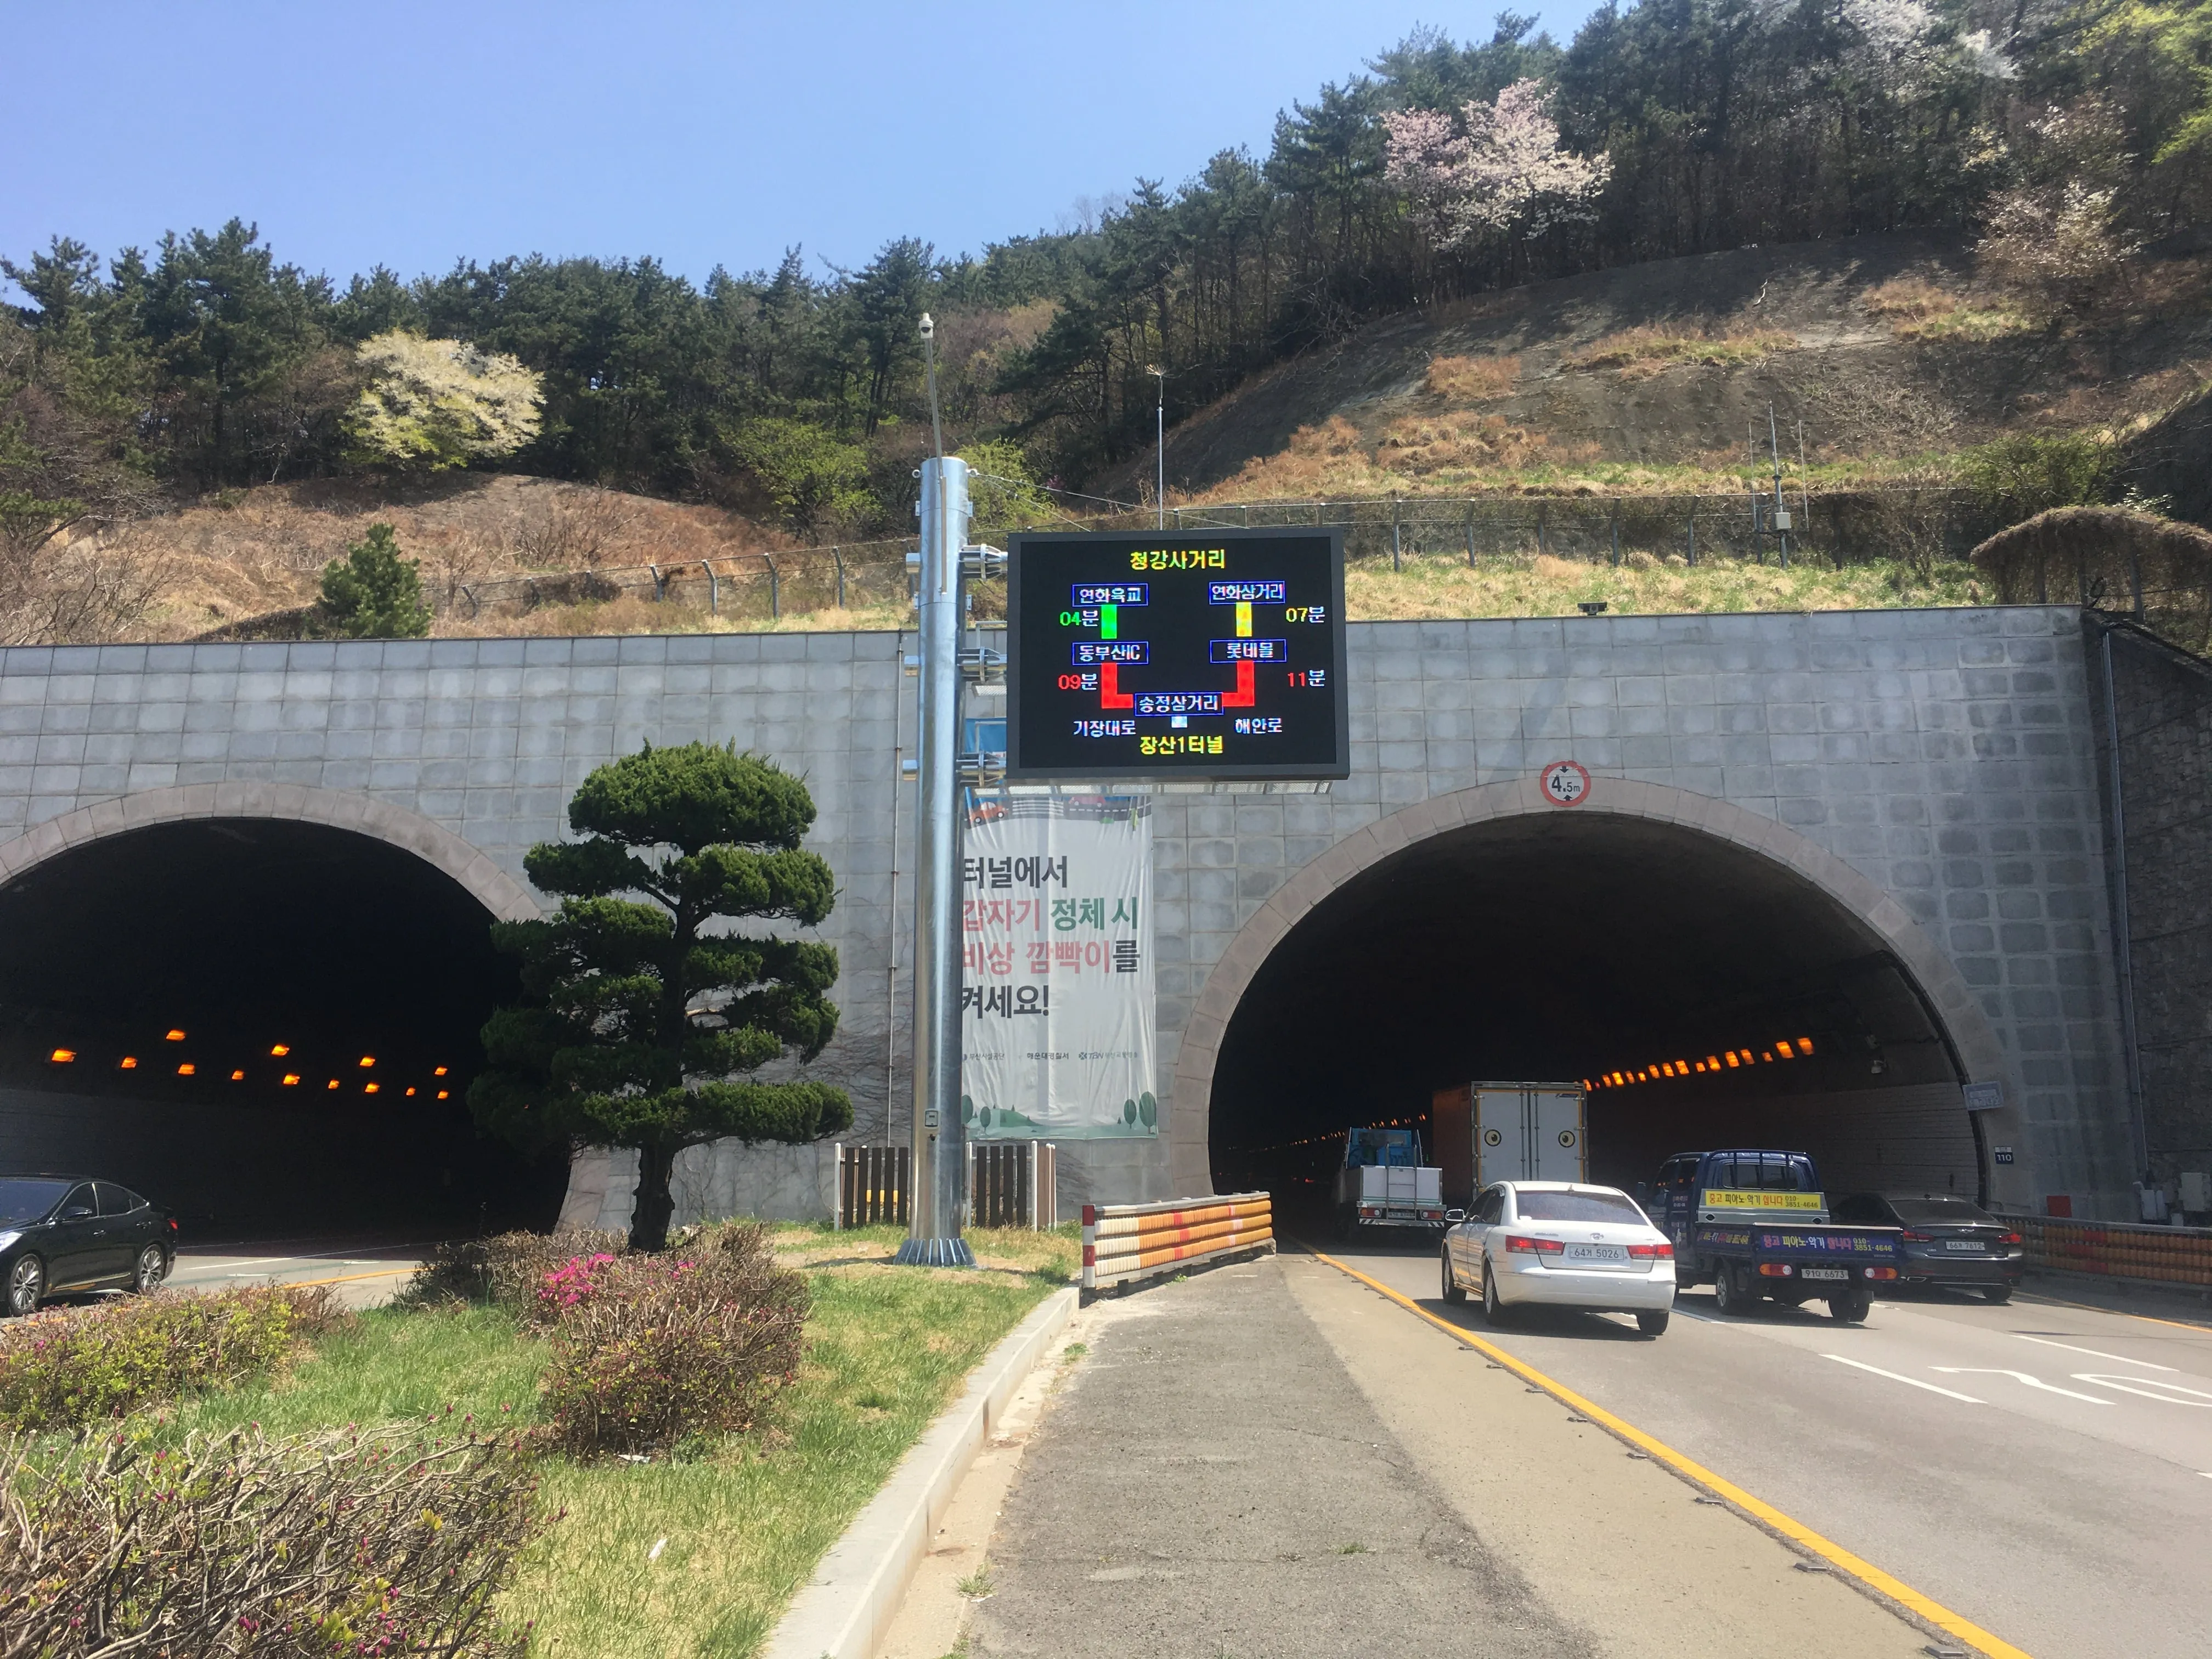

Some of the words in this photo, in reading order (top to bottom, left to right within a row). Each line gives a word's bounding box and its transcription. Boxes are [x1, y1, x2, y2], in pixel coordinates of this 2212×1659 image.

[1130, 549, 1225, 570] 청강사거리
[1079, 588, 1141, 603] 연화육교
[1211, 584, 1283, 600] 연화삼거리
[1059, 610, 1099, 627] 04분
[1286, 606, 1325, 623] 07분
[1079, 645, 1141, 662] 동부산IC
[1226, 642, 1273, 658] 롯데몰
[1058, 673, 1098, 690] 09분
[1288, 669, 1325, 687] 11분
[1139, 695, 1218, 713] 송정삼거리
[1073, 720, 1136, 738] 기장대로
[1234, 718, 1283, 735] 해안로
[1139, 736, 1224, 755] 장산1터널
[1551, 775, 1581, 792] 4.5m
[963, 856, 1068, 889] 터널에서
[963, 898, 1040, 932] 갑자기
[1051, 898, 1105, 931] 정체
[1111, 896, 1138, 930] 시
[962, 942, 1015, 975] 비상
[1026, 940, 1141, 974] 깜빡이를
[961, 985, 1049, 1019] 켜세요!
[1575, 1248, 1592, 1257] 64거
[1596, 1249, 1619, 1259] 5026
